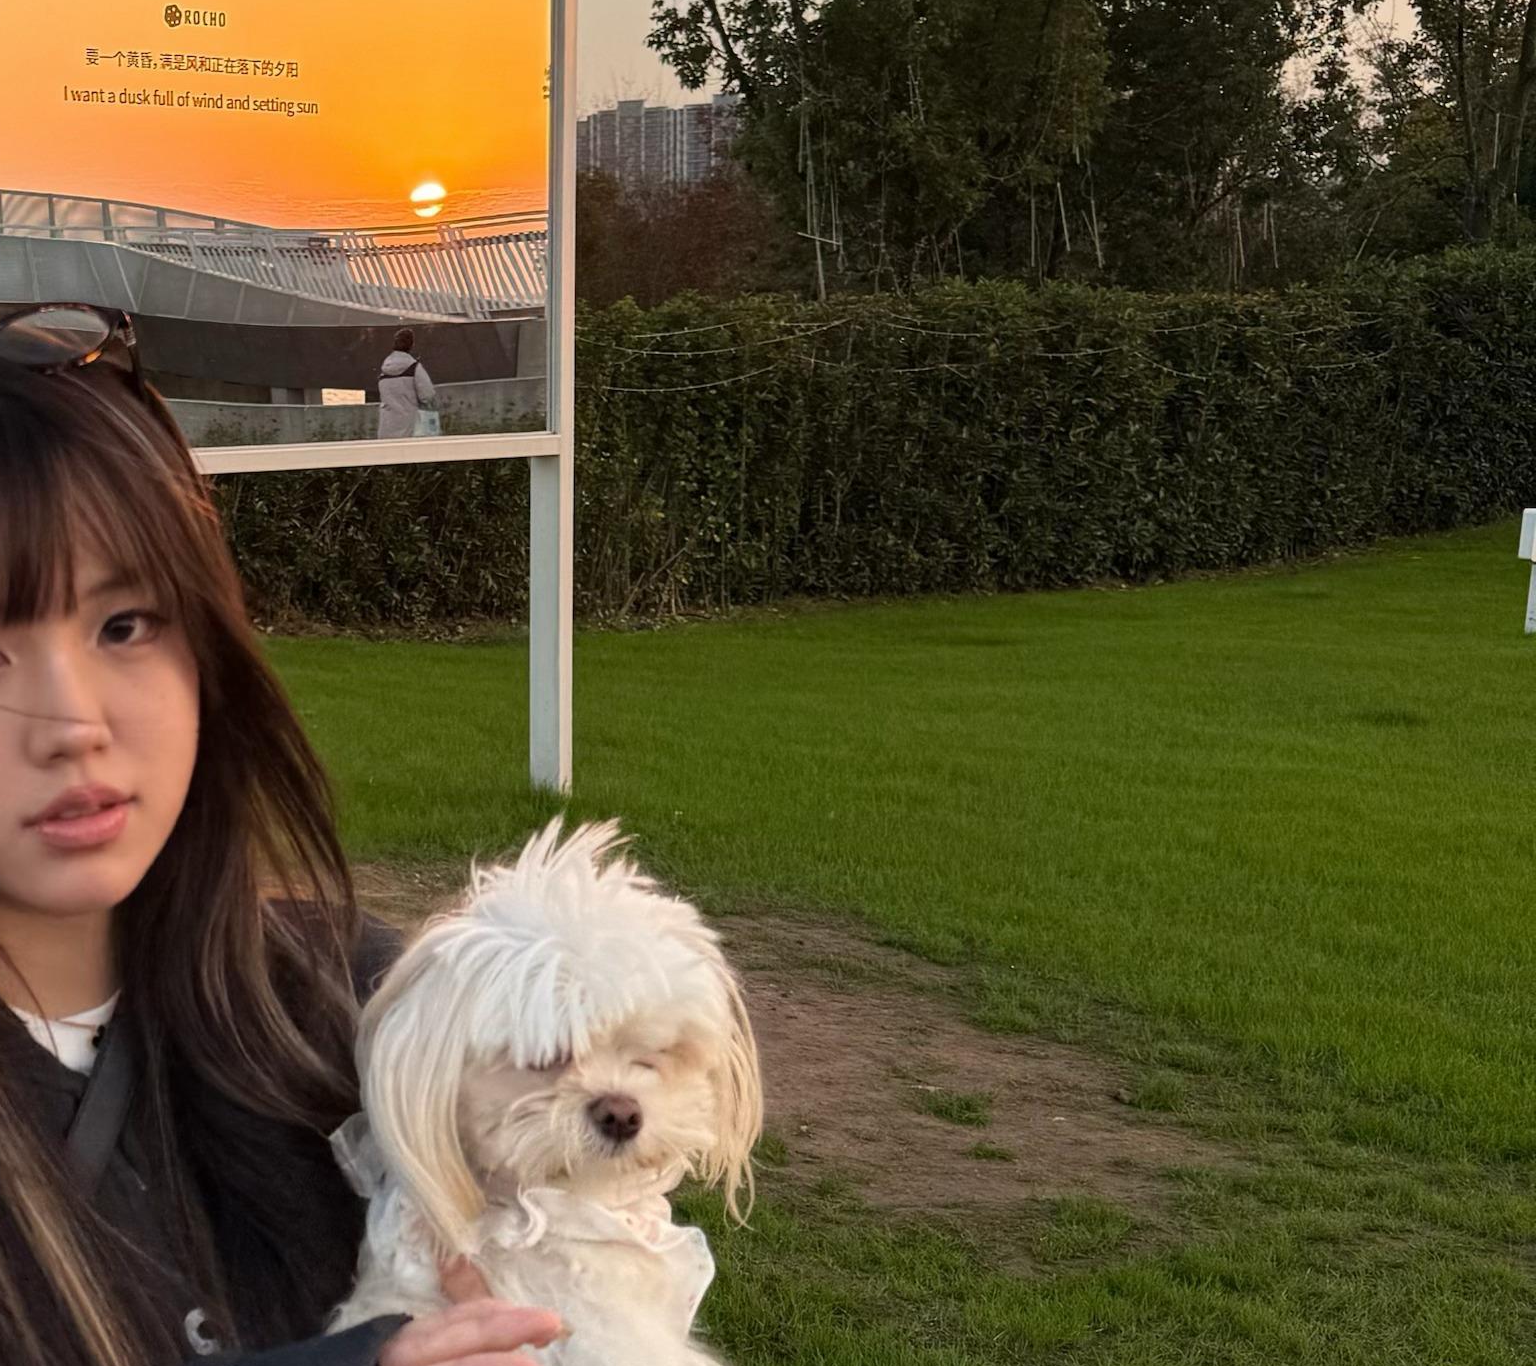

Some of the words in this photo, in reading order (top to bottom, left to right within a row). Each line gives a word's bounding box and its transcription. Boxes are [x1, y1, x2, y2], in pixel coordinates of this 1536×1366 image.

[184, 9, 226, 27] ROCHO
[64, 85, 68, 101] I
[70, 88, 105, 103] want
[107, 91, 116, 103] a
[119, 87, 151, 105] dusk
[153, 89, 174, 107] full
[176, 90, 191, 107] of
[191, 92, 223, 109] wind
[226, 94, 250, 110] and
[252, 97, 295, 117] setting
[296, 101, 319, 115] sun
